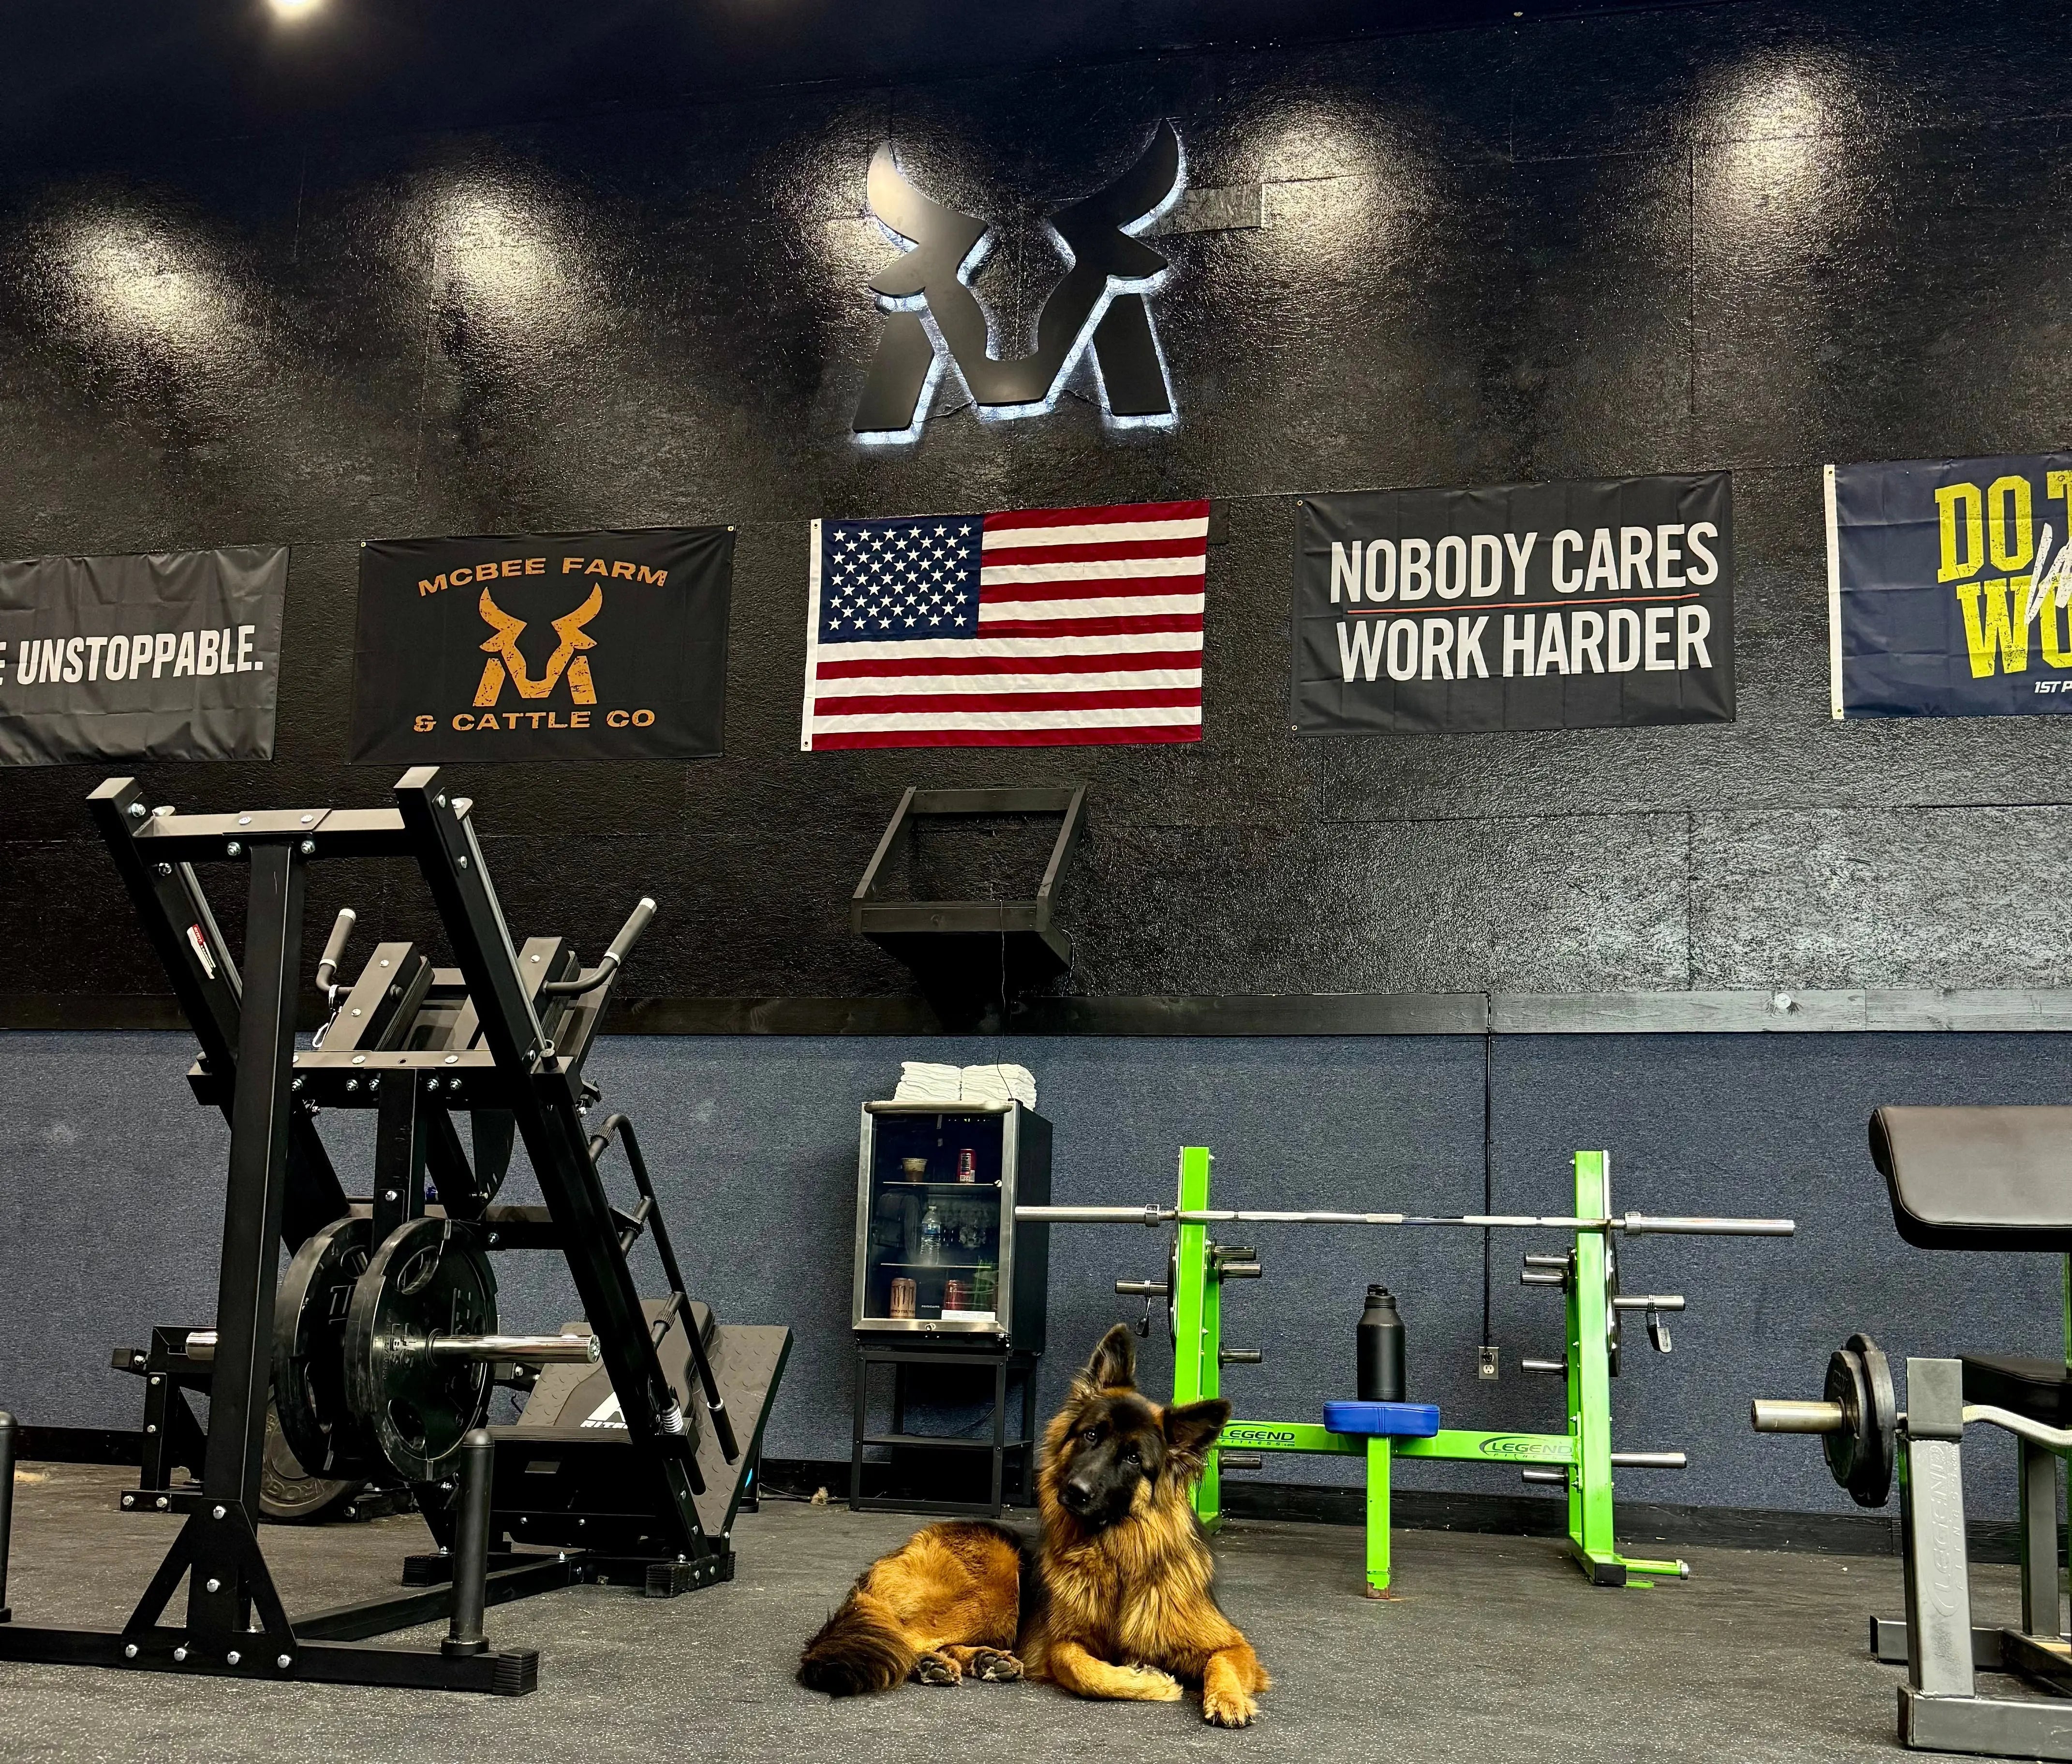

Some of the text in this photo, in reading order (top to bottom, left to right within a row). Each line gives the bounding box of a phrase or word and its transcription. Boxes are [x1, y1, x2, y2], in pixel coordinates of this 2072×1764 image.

[1935, 475, 2033, 583] DO
[419, 558, 667, 596] MCBEE FARM
[1331, 522, 1718, 603] NOBODY CARES
[17, 625, 263, 685] UNSTOPPABLE.
[1336, 605, 1713, 682] WORK HARDER
[2034, 681, 2061, 693] 1ST
[413, 709, 655, 732] & CATTLE CO
[1220, 1429, 1295, 1441] LEGEND
[1492, 1442, 1572, 1454] LEGEND
[1929, 1445, 1950, 1592] LEGEND
